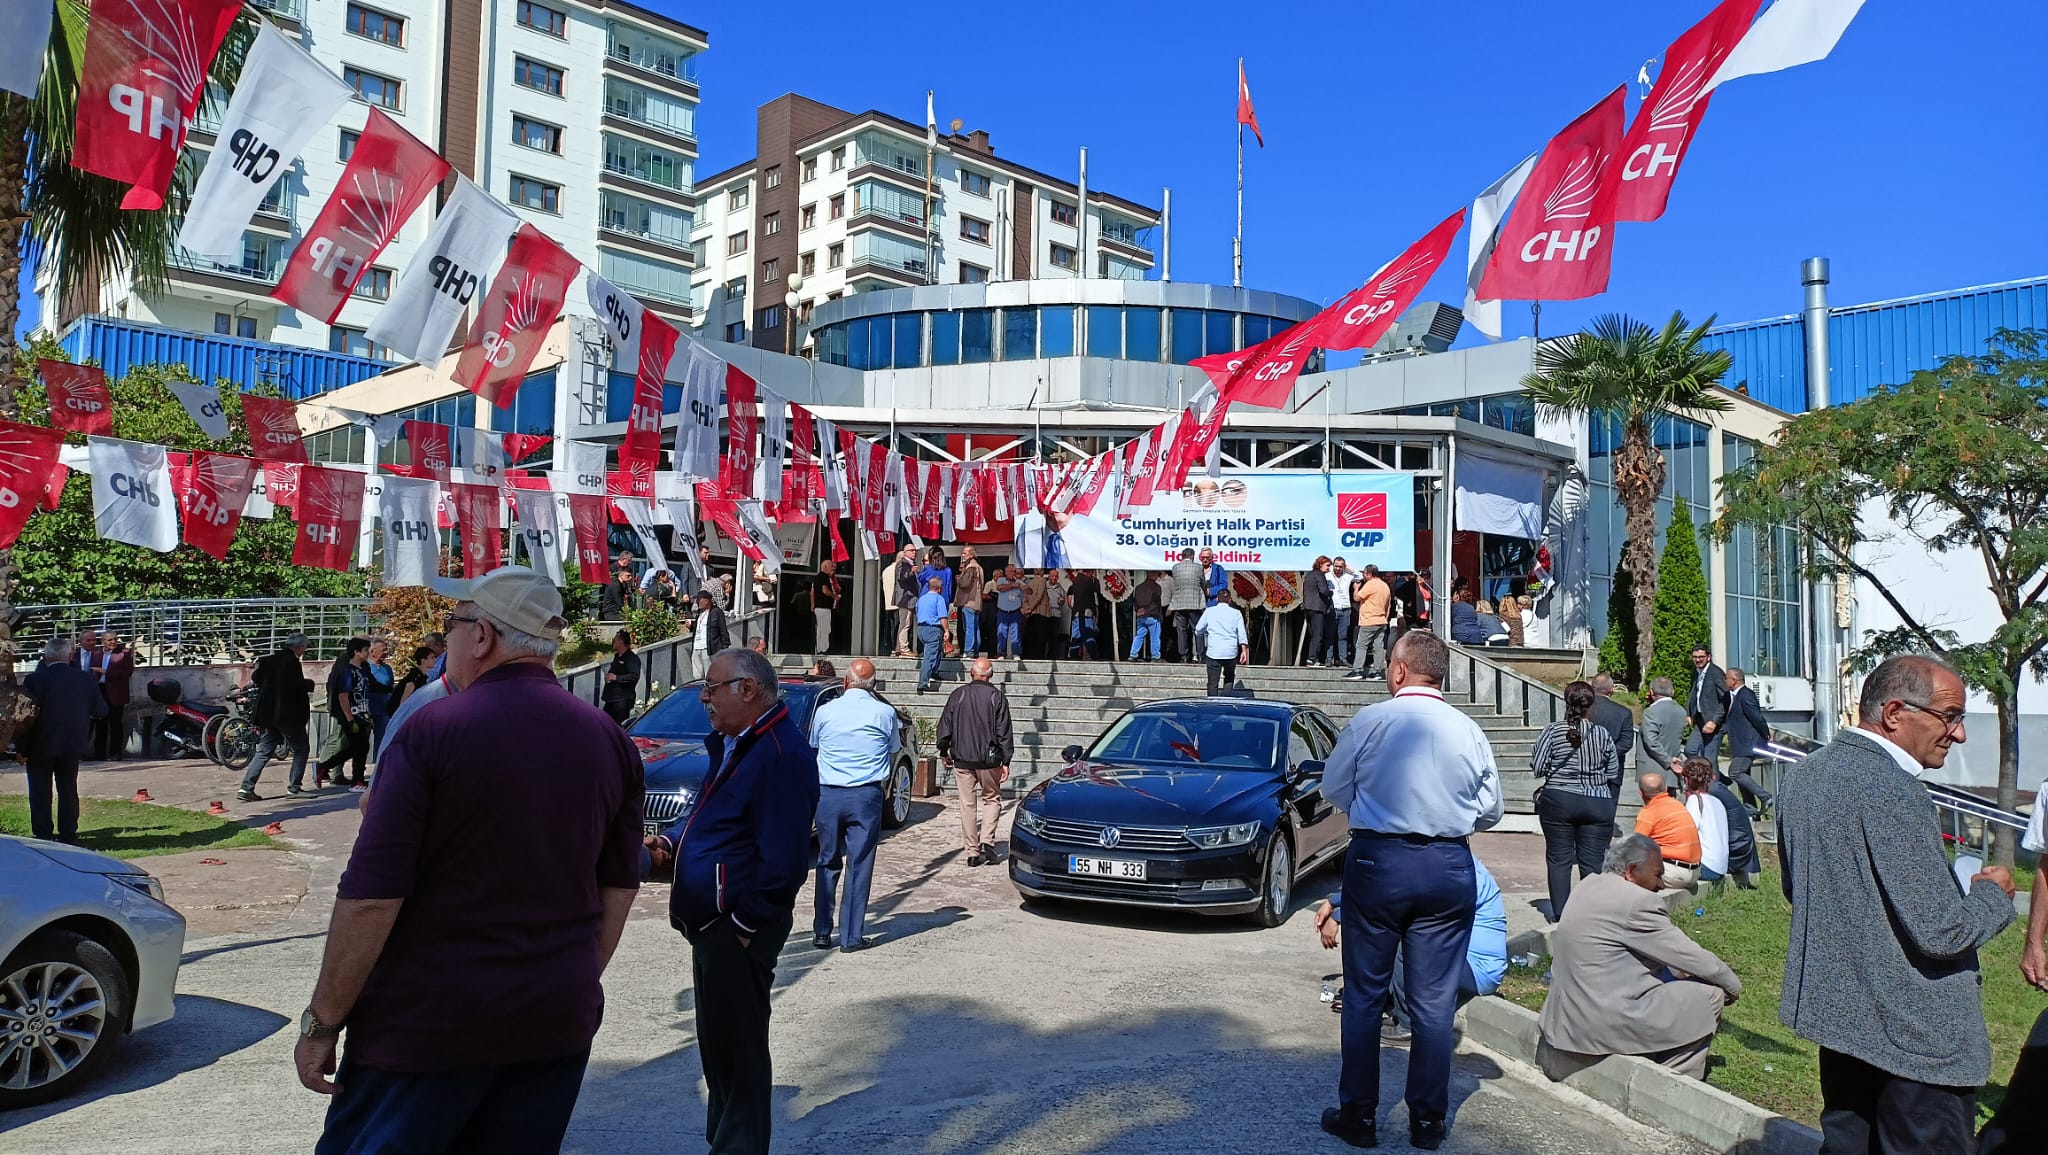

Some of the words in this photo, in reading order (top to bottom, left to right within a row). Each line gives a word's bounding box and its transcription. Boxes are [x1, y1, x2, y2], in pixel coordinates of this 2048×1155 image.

[1621, 142, 1679, 181] CH
[1520, 225, 1601, 263] CHP
[1344, 299, 1395, 326] CHP
[1254, 361, 1294, 381] CHP
[65, 398, 103, 413] CHP
[200, 400, 223, 418] CH
[265, 432, 300, 445] CHP
[423, 458, 446, 471] CHP
[577, 474, 602, 488] CHP
[1121, 517, 1212, 532] Cumhuriyet
[1217, 517, 1251, 531] Halk
[1255, 517, 1306, 531] Partisi
[1115, 533, 1139, 546] 38.
[1143, 533, 1199, 549] Olağan
[1203, 532, 1212, 546] İl
[1217, 534, 1311, 549] Kongremize
[1341, 531, 1384, 548] CHP
[1164, 551, 1183, 563] Ho
[1199, 550, 1262, 563] eldiniz
[1076, 858, 1090, 873] 55
[1097, 860, 1112, 875] NH
[1122, 862, 1143, 877] 333
